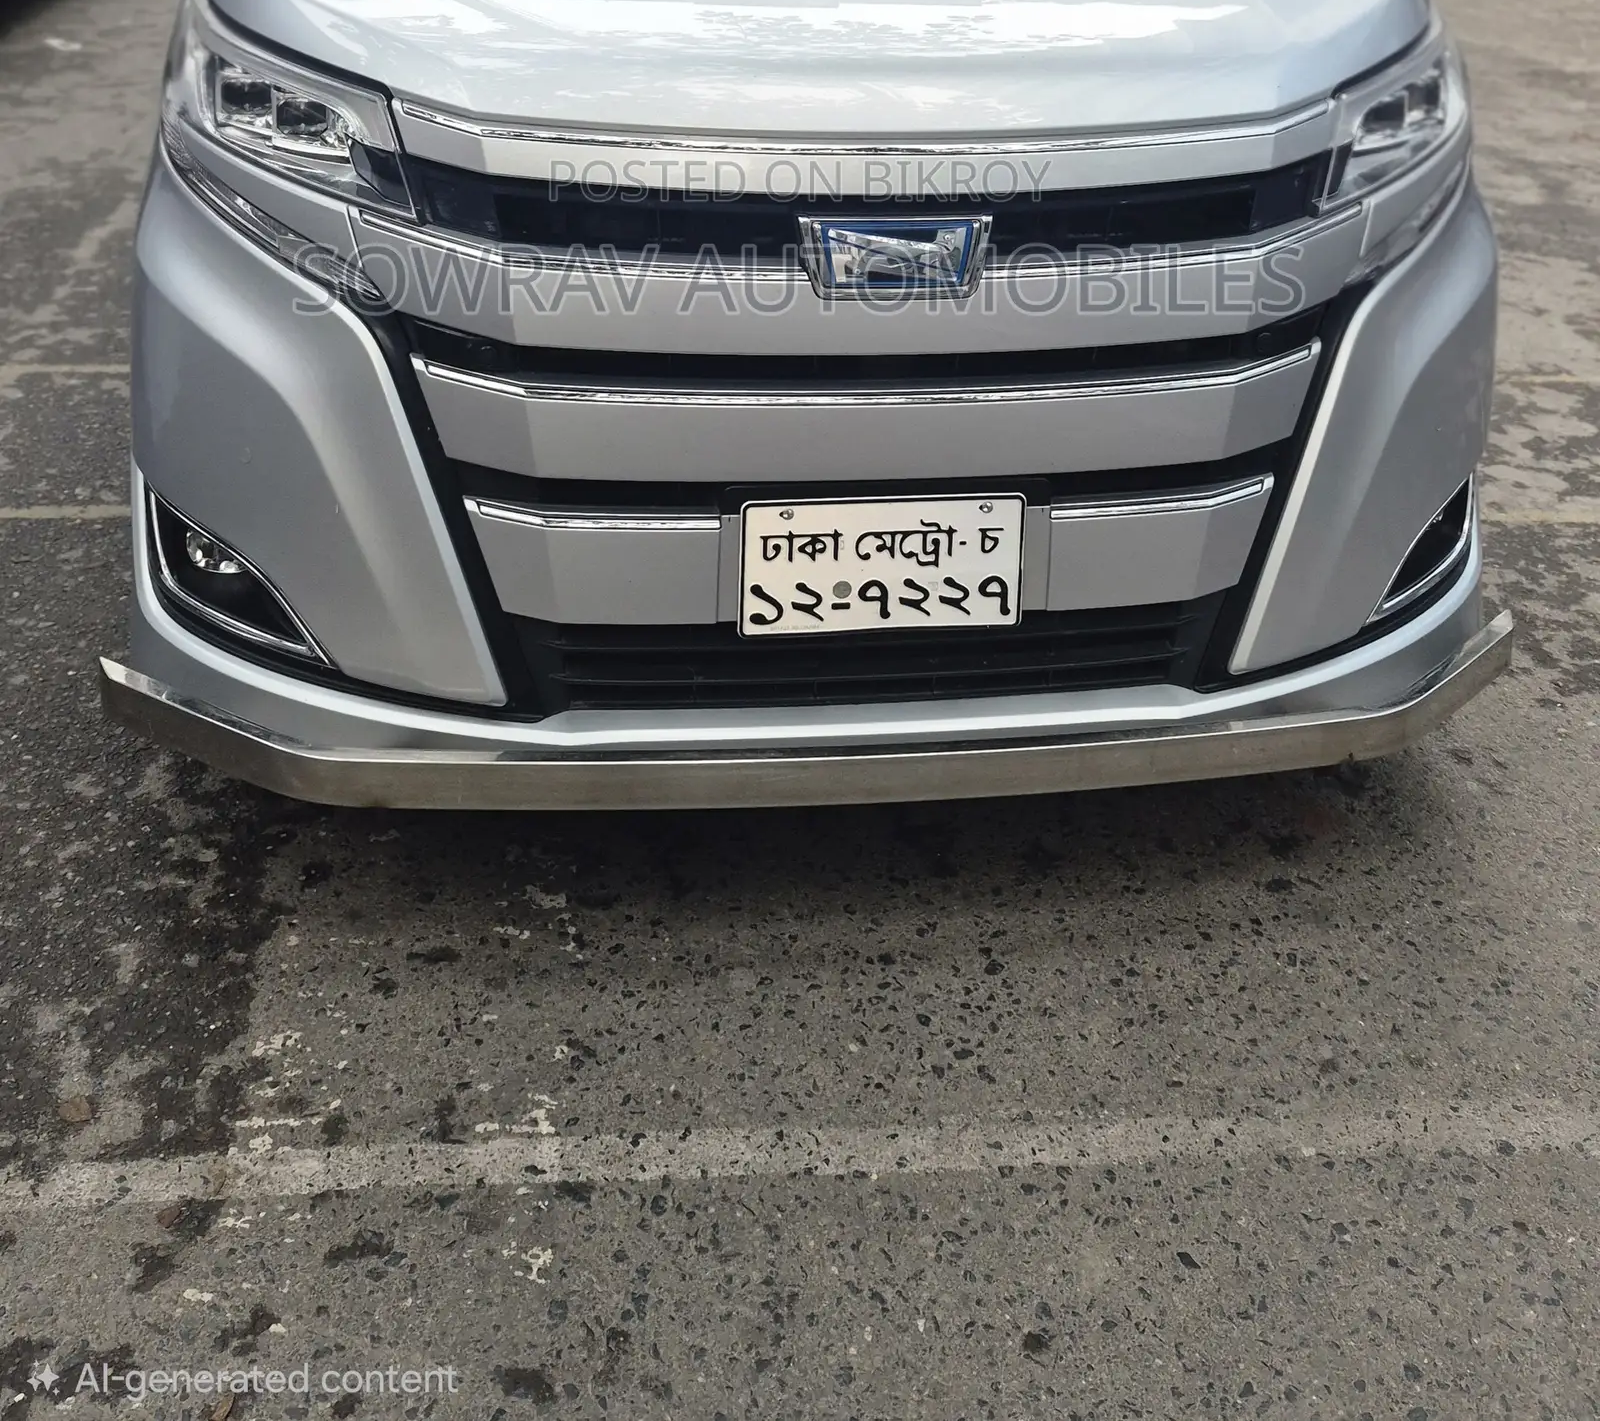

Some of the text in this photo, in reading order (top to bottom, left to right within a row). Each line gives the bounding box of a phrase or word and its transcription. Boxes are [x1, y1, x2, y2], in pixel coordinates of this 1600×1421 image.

[760, 529, 843, 563] ঢাকা
[978, 527, 1004, 554] চ
[749, 575, 1011, 625] ১২-৭২২৭
